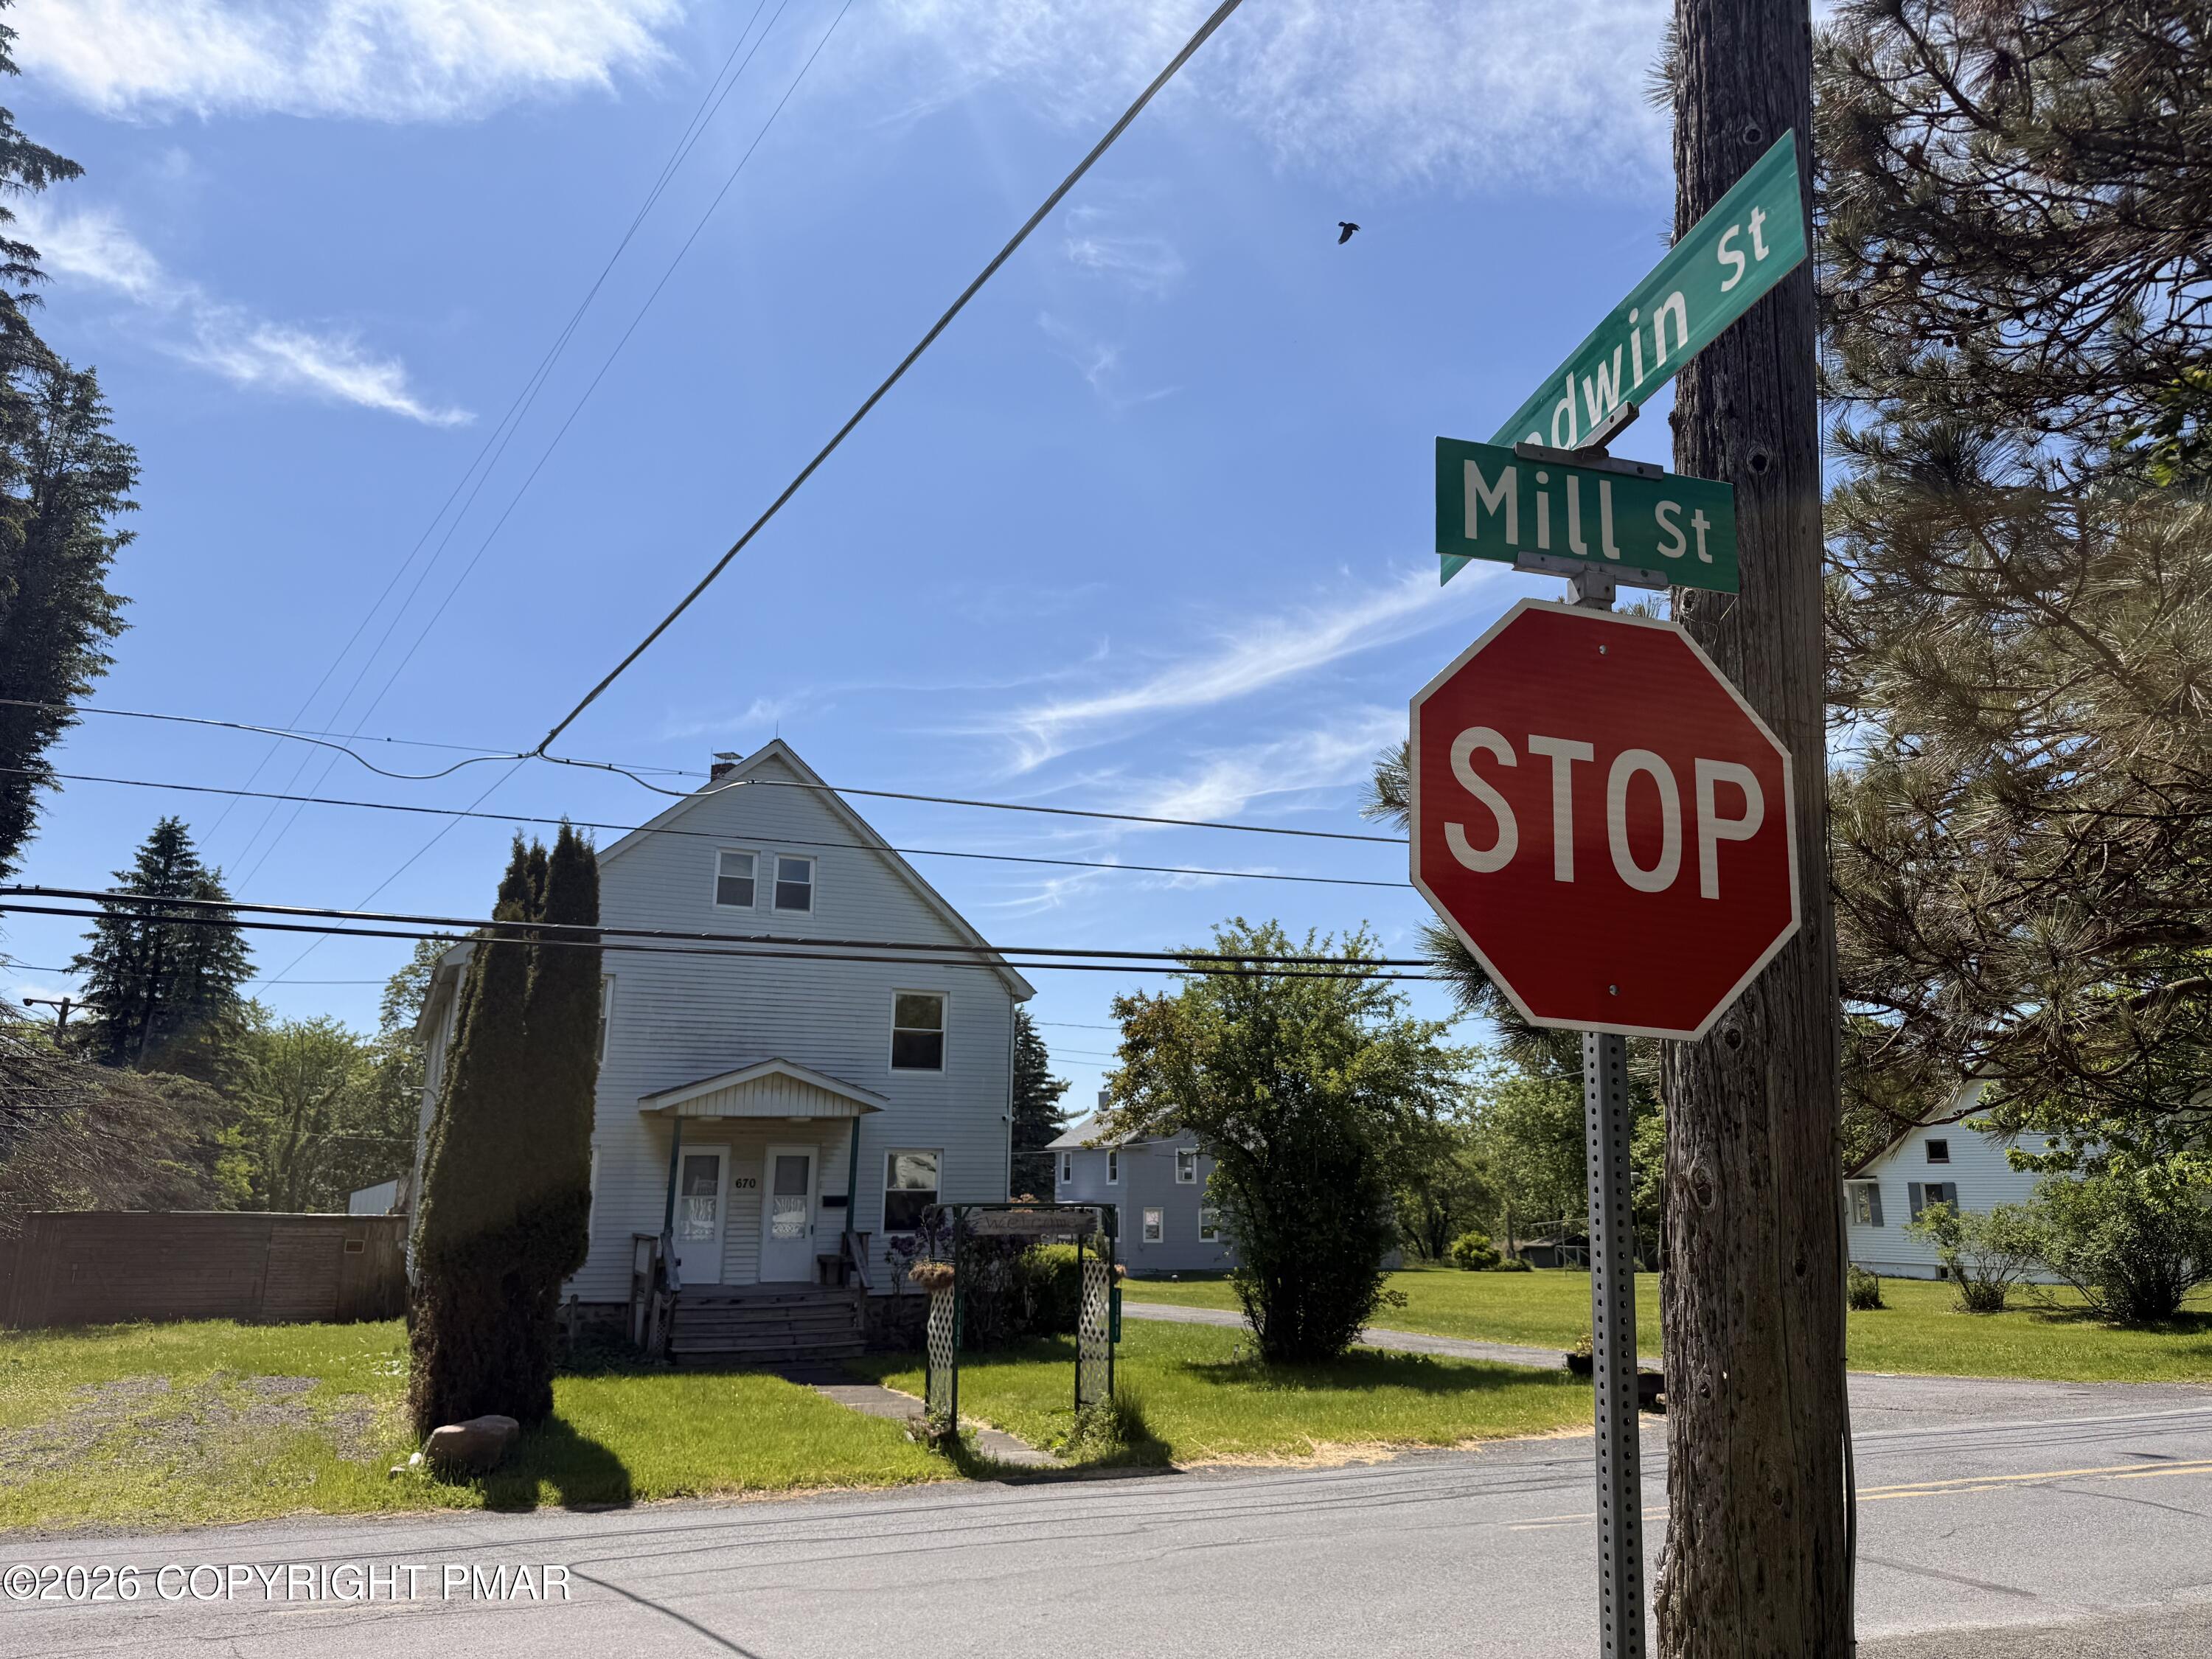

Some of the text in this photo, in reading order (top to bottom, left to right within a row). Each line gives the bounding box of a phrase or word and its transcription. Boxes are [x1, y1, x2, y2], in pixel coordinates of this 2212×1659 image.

[1523, 205, 1770, 451] dwin St
[1463, 459, 1713, 565] Mill St
[1443, 726, 1765, 900] STOP
[735, 1178, 757, 1189] 670
